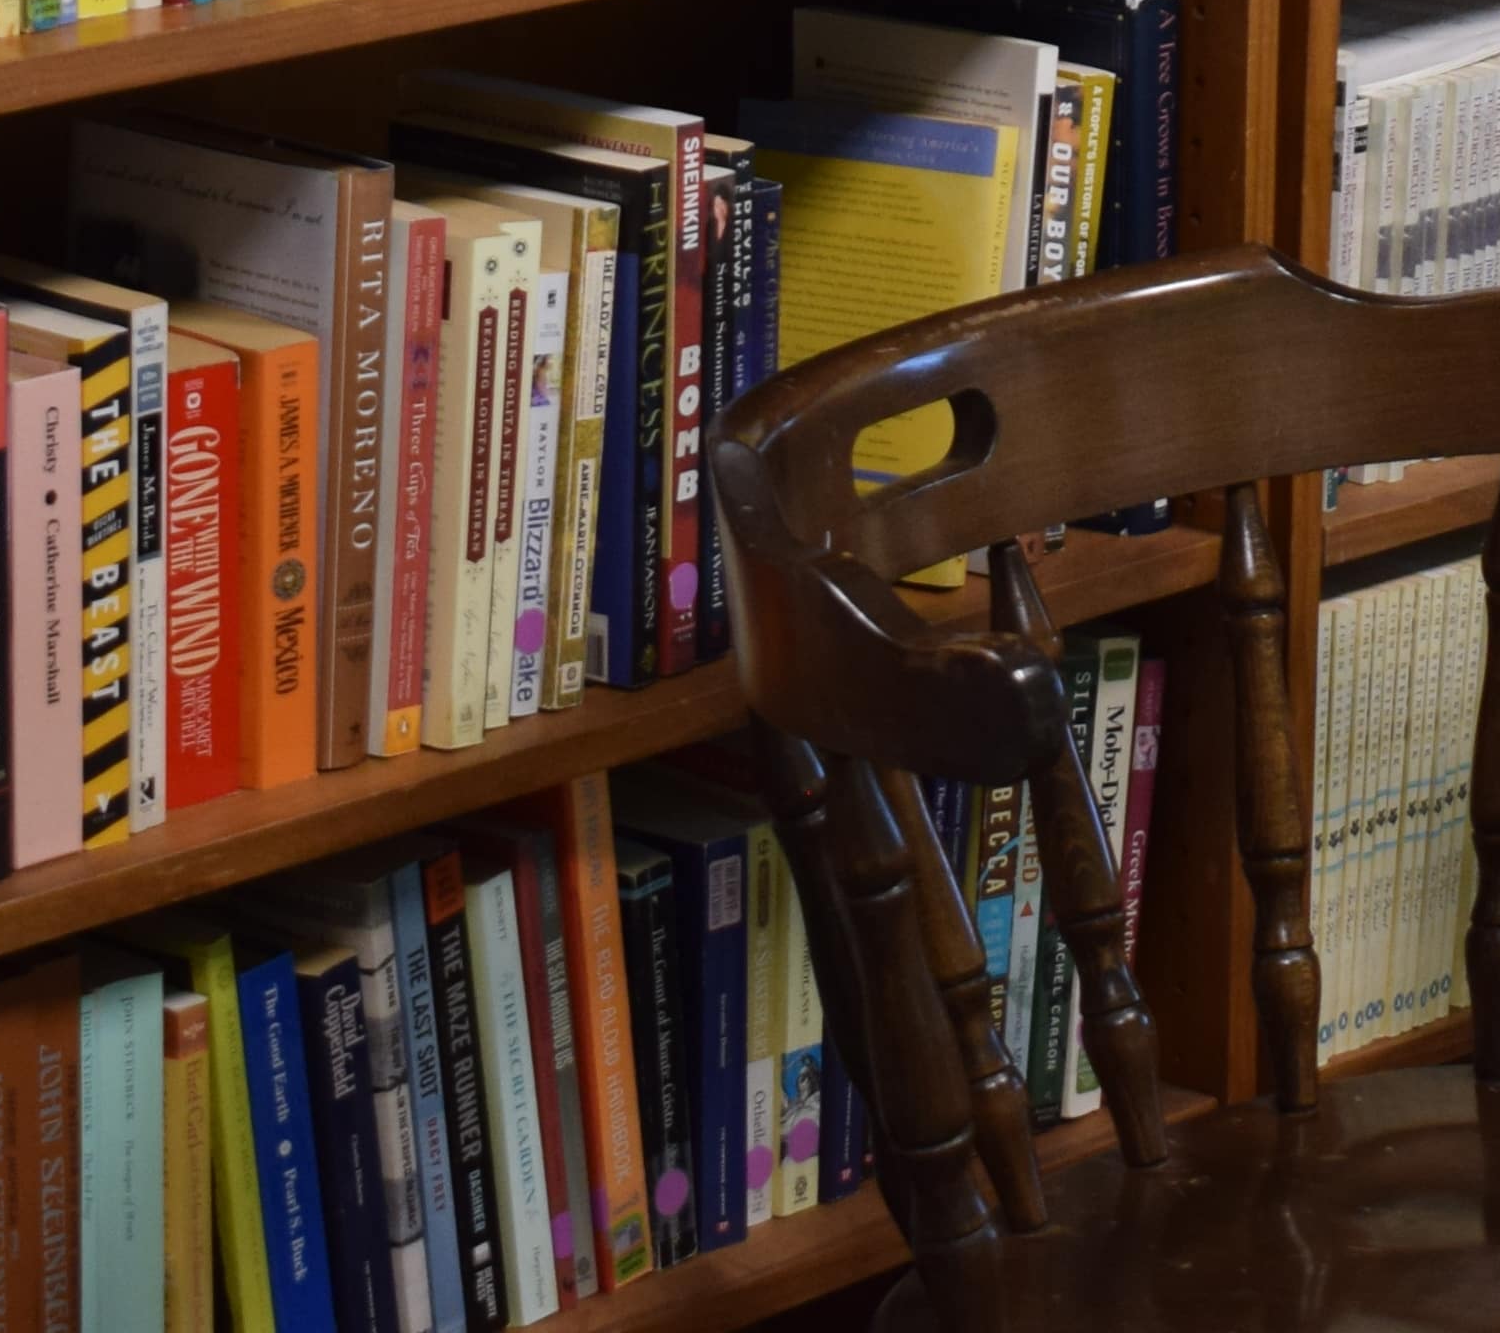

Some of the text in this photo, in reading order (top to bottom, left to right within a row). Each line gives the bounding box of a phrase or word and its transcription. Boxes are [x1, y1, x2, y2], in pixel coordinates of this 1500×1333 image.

[682, 137, 700, 251] SHEINKIN
[351, 219, 385, 550] RITA MORENO
[640, 220, 666, 447] PRINCESS
[90, 400, 120, 486] THE
[277, 397, 300, 554] JAMES MICHENER
[402, 396, 428, 561] Three Cups Tea
[535, 423, 549, 487] NAYLOR
[675, 345, 700, 502] BOMB
[44, 407, 61, 707] Christy Catherine Marshall
[168, 425, 221, 677] GONE WITH THE WIND
[90, 564, 121, 700] BEAST
[275, 604, 305, 696] Mexico
[194, 675, 213, 759] MARGARET
[264, 987, 277, 1013] The
[273, 1070, 289, 1123] Earth
[322, 983, 356, 1099] Copperfield
[342, 990, 365, 1045] David
[406, 945, 438, 1099] THE LAST SHOT
[441, 925, 486, 1233] THE MAZE RUNNER DASHNER
[283, 1169, 308, 1283] Pearl Buck
